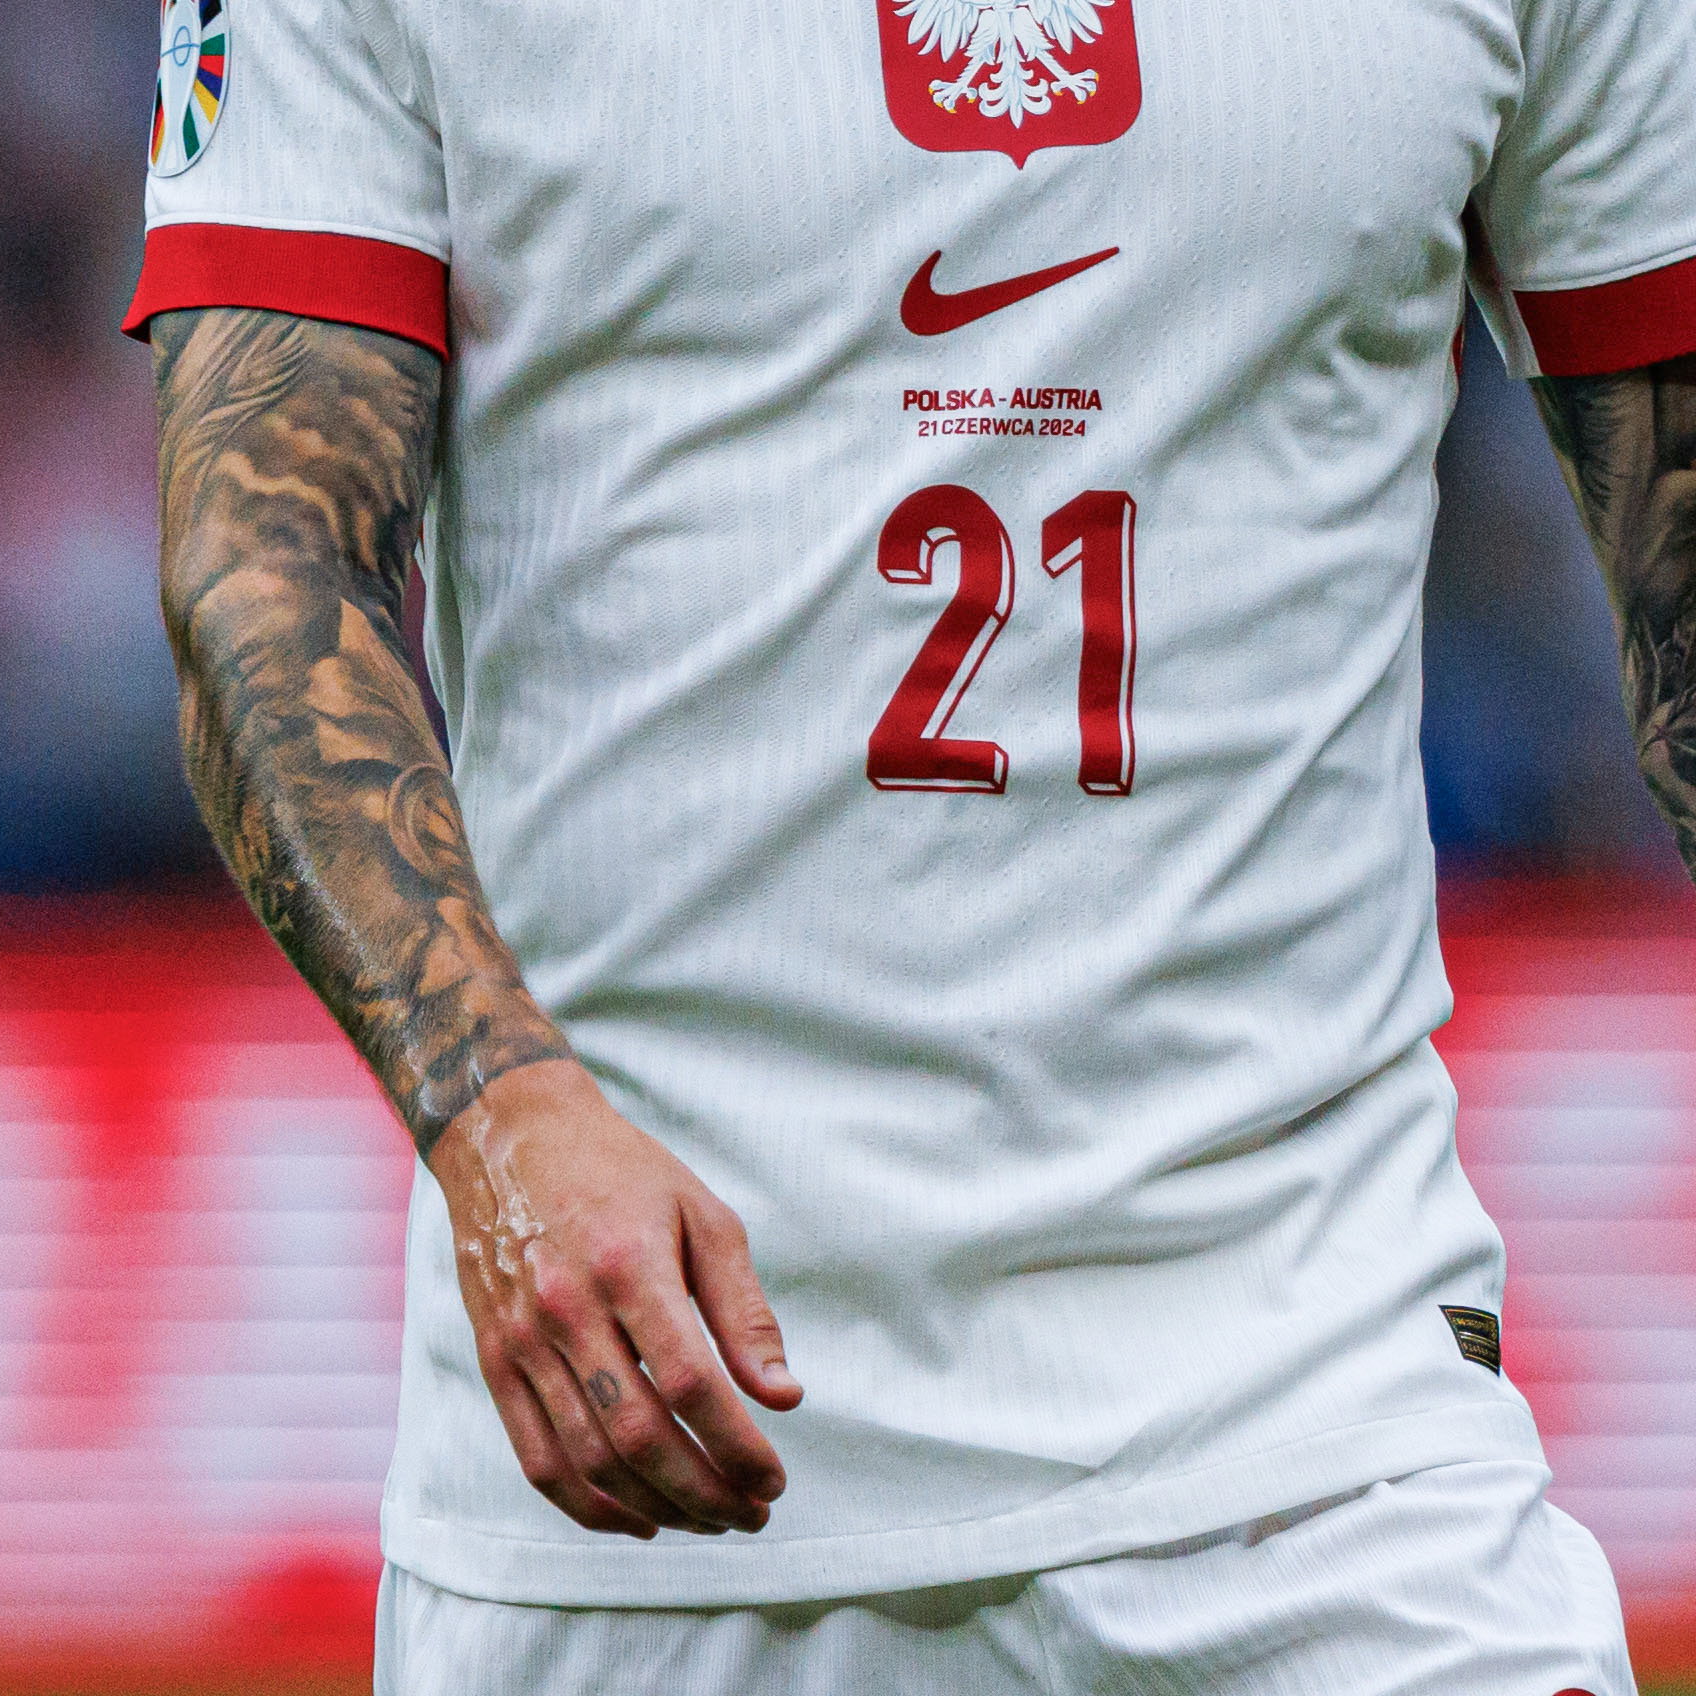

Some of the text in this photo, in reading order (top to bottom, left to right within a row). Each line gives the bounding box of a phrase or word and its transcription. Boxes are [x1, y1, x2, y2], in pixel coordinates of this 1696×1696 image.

[903, 388, 995, 411] POLSKA
[1009, 387, 1102, 410] AUSTRIA
[917, 417, 1086, 436] 21 CZERWCA 2024
[866, 484, 1137, 797] 21
